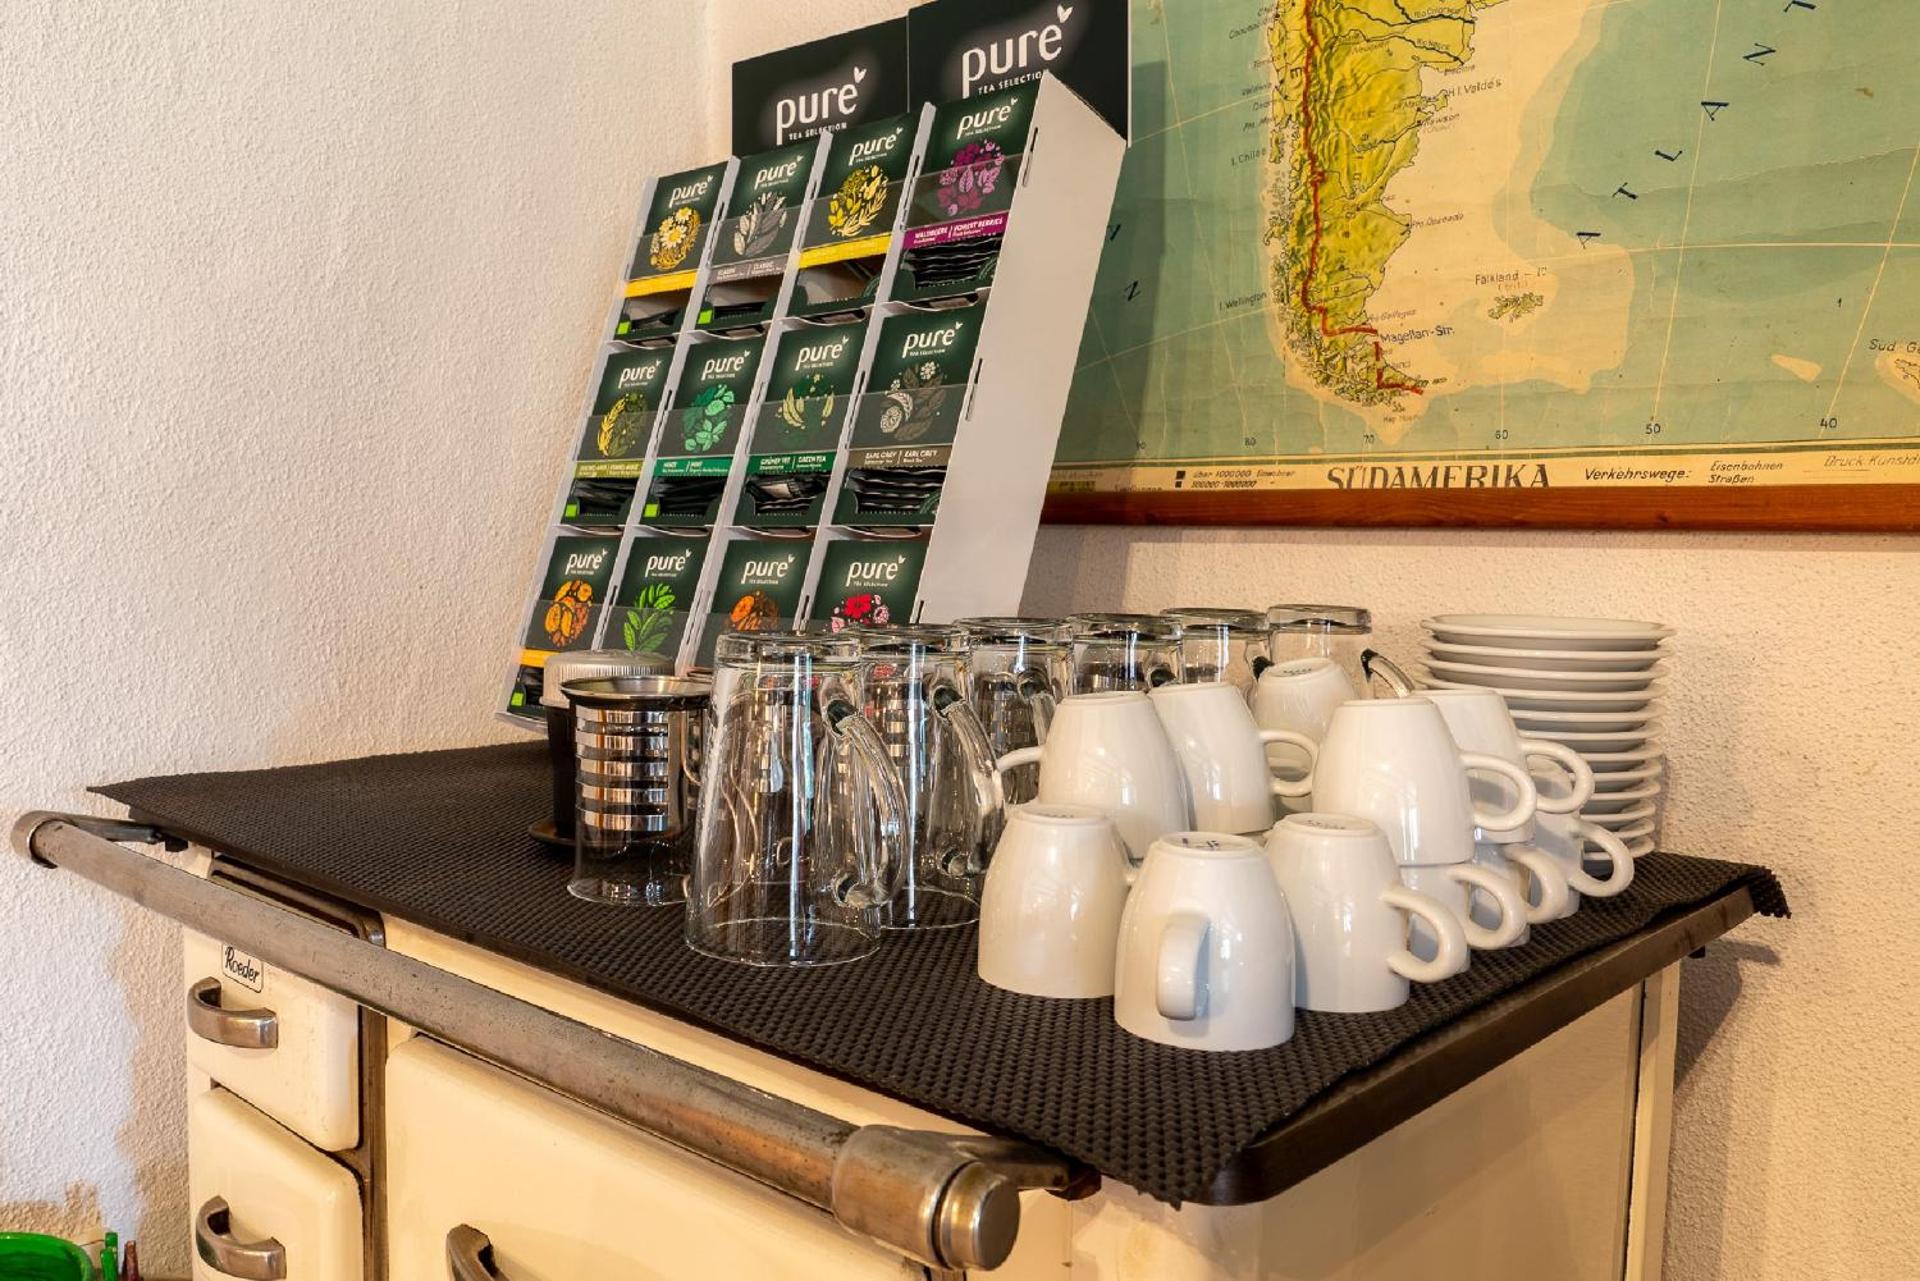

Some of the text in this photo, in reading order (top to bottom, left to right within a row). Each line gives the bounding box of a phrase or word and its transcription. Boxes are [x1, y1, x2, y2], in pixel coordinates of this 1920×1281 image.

[962, 24, 1063, 99] pure
[978, 71, 1042, 96] TEA SELECTIO
[776, 83, 858, 146] pure
[957, 105, 1011, 140] pure
[788, 132, 803, 141] TEA
[849, 134, 897, 166] pure
[754, 161, 798, 191] pure
[668, 180, 708, 208] pure
[902, 329, 955, 359] pure
[701, 356, 744, 381] pure
[795, 343, 843, 371] pure
[618, 365, 656, 389] pure
[1645, 423, 1661, 435] 50
[1819, 417, 1838, 429] 40
[1824, 455, 1863, 467] Druck
[1327, 463, 1551, 489] SÜDAMERIKA
[1585, 467, 1693, 483] Verkehrswege:
[1708, 474, 1755, 485] Straßen
[565, 552, 603, 575] pure
[645, 554, 686, 578] pure
[741, 561, 788, 584] pure
[845, 561, 898, 587] pure
[225, 946, 260, 983] Roeder
